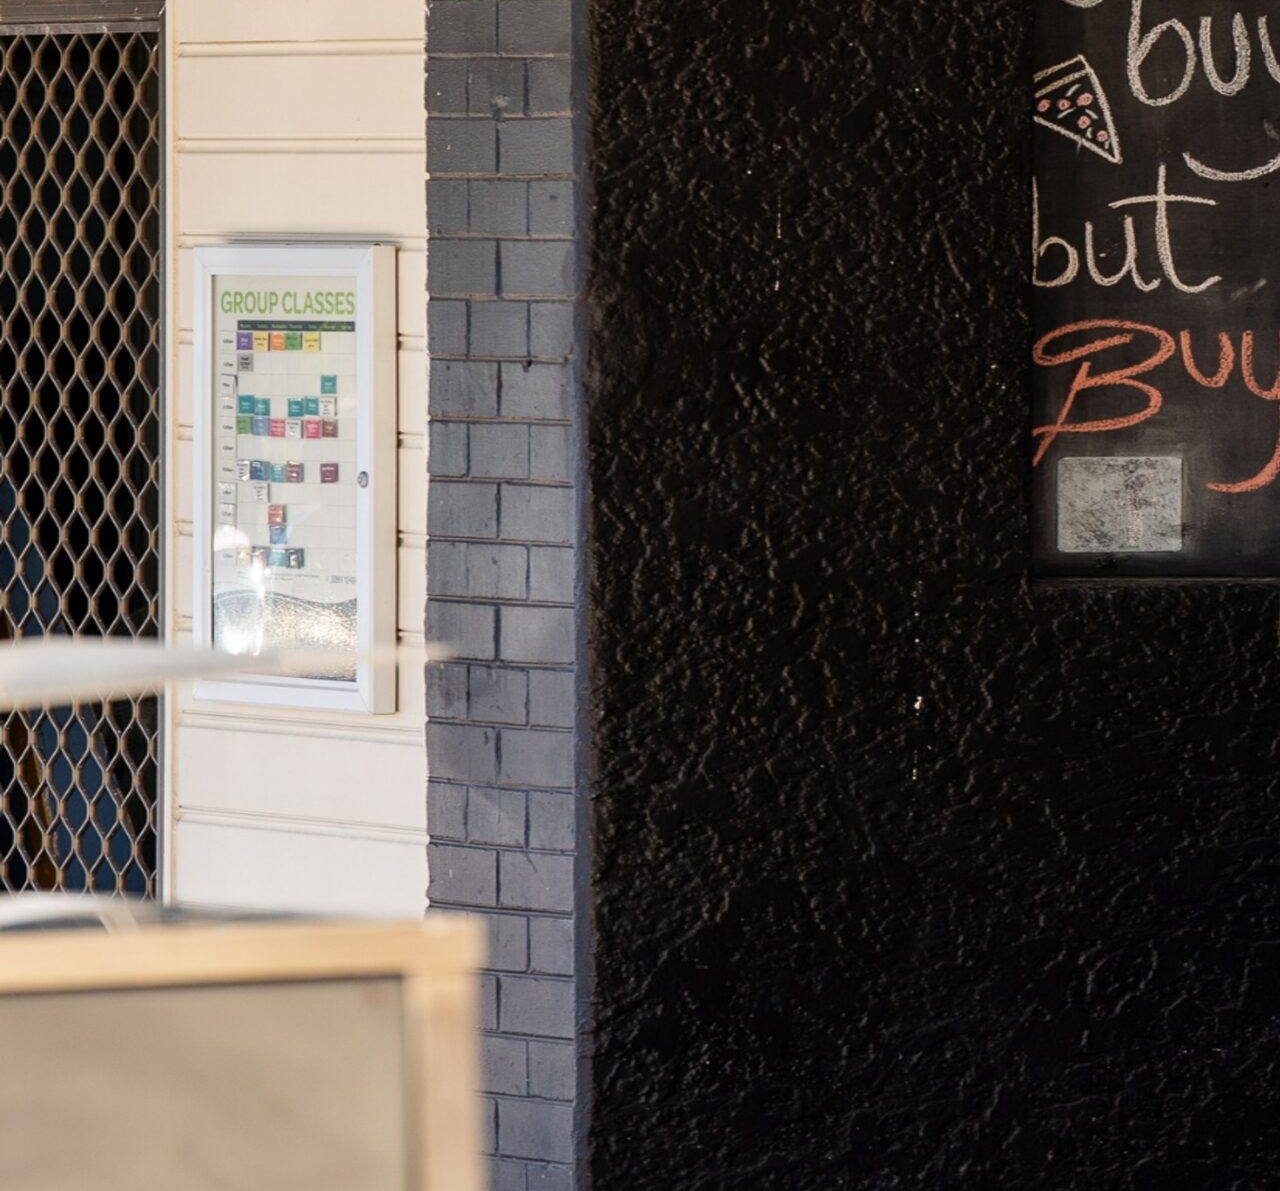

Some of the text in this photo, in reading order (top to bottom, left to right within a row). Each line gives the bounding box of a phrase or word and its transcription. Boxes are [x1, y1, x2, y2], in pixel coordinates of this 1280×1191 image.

[1031, 174, 1224, 294] but
[220, 290, 356, 315] GROUP CLASSES
